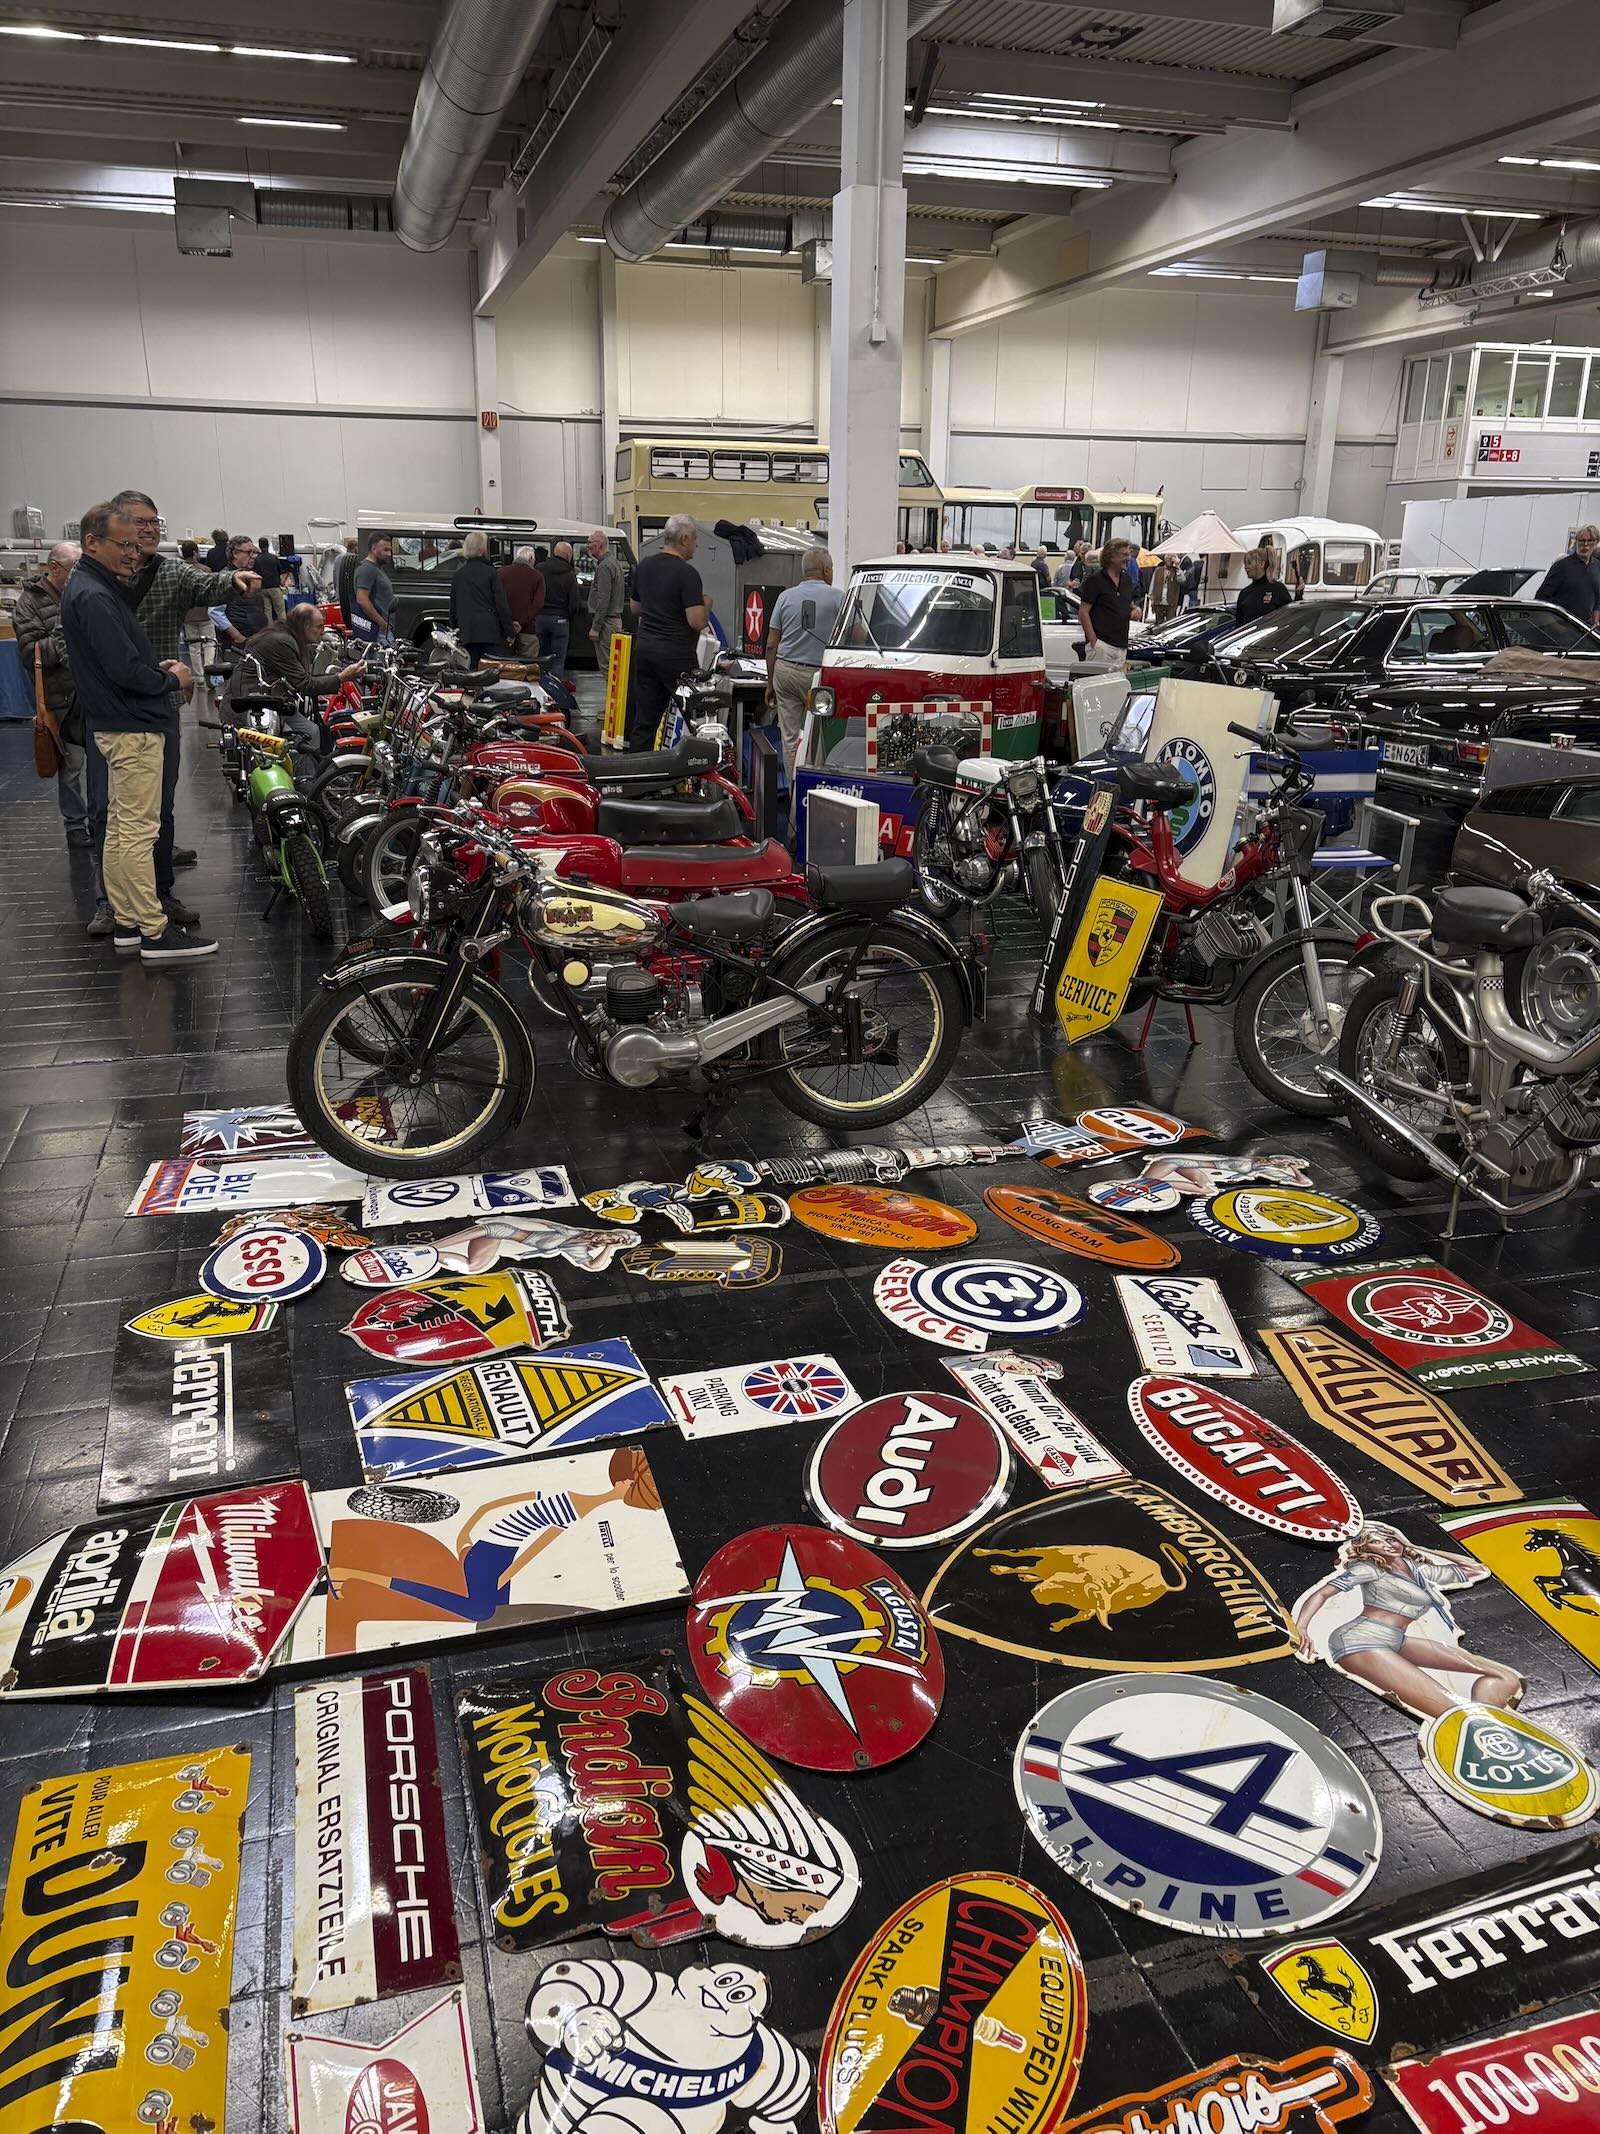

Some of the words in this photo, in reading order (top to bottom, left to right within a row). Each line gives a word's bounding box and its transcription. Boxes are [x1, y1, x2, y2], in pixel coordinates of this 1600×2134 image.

[1493, 437, 1499, 447] 5
[1502, 450, 1517, 461] 1-8
[891, 572, 940, 584] Alitalia
[240, 732, 280, 747] ITALJET
[1101, 899, 1137, 917] PORSCHE
[1058, 973, 1118, 1016] SERVICE
[1095, 1110, 1172, 1146] Gulf
[180, 1175, 221, 1207] OEL
[717, 1204, 732, 1217] OIL
[1106, 1181, 1163, 1204] MARTINI
[1241, 1195, 1262, 1230] PEUGEOT
[806, 1210, 847, 1224] PIONEER
[849, 1220, 914, 1242] MOTORCYCLE
[829, 1222, 852, 1234] SINCE
[840, 1211, 893, 1229] AMERICA'S
[1011, 1205, 1063, 1230] RACING
[1063, 1227, 1105, 1249] TEAM
[357, 1253, 384, 1279] SERVIZIO
[519, 1269, 559, 1338] ABARTH
[881, 1263, 974, 1345] SERVICE
[1129, 1278, 1222, 1339] Vespa
[1142, 1314, 1177, 1366] SERVIZIO
[1418, 1352, 1584, 1382] MOTOR-SERVICE
[168, 1342, 238, 1482] Ferrari
[464, 1388, 488, 1433] NATIONALE
[478, 1361, 539, 1437] RENAULT
[687, 1387, 714, 1411] ONLY
[703, 1376, 740, 1417] PARKING
[970, 1372, 1006, 1396] nicht
[989, 1393, 1017, 1414] das
[1289, 1334, 1480, 1485] JAGUAR
[855, 1396, 960, 1527] Audi
[1045, 1446, 1072, 1475] GASOLIN
[1145, 1387, 1328, 1515] BUGATTI
[597, 1520, 614, 1548] PIRELLI
[603, 1552, 614, 1565] per
[1105, 1483, 1277, 1640] LAMBORGHINI
[31, 1556, 77, 1648] RACING
[45, 1528, 129, 1642] aprilia
[612, 1575, 625, 1602] scooter
[870, 1585, 918, 1653] AGUSTA
[316, 1690, 342, 1792] ORIGINAL
[542, 1668, 676, 1902] Indian
[1466, 1747, 1565, 1784] LOTUS
[94, 1774, 112, 1805] POUR
[29, 1783, 79, 1862] VITE
[81, 1803, 102, 1841] ALLER
[383, 1676, 434, 1963] PORSCHE
[472, 1701, 570, 1929] MOTOCYCLES
[1035, 1803, 1291, 1923] ALPINE
[317, 1796, 347, 1981] ERSATZTEILE
[863, 1917, 925, 1990] SPARK
[836, 1994, 879, 2086] PLUGS
[1023, 1955, 1066, 2086] EQUIPPED
[588, 2051, 746, 2099] MICHELIN
[1427, 2062, 1540, 2134] 100
